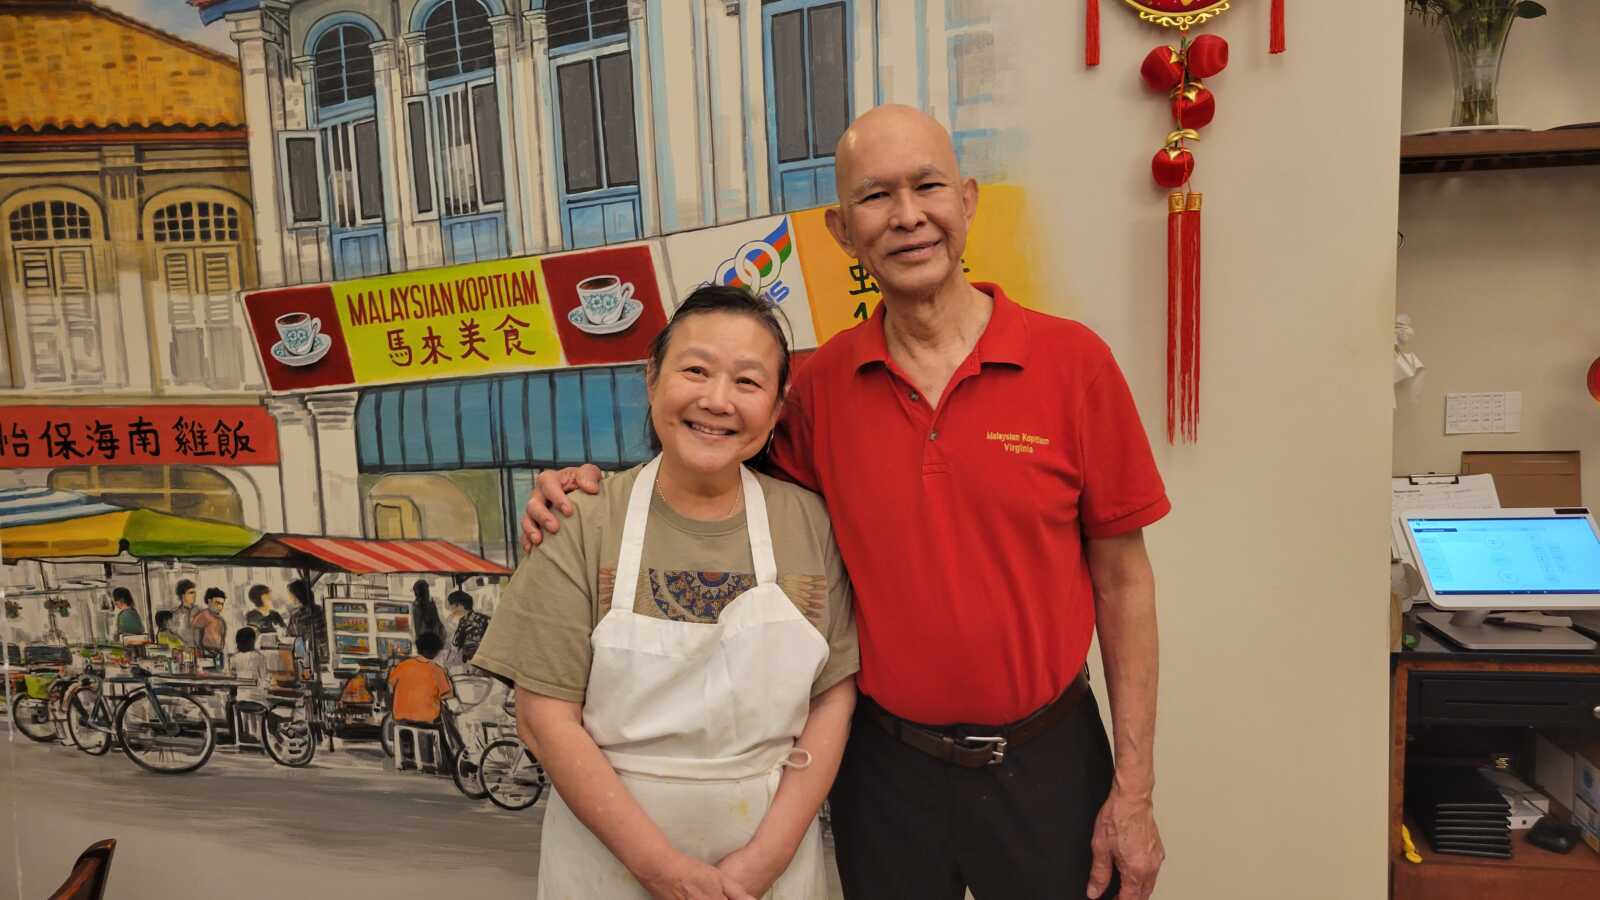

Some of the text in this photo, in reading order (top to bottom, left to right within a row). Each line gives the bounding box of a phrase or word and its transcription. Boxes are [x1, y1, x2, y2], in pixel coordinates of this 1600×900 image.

[346, 270, 540, 326] MALAYSIAN KOPITIAM
[386, 314, 536, 367] 馬來美食
